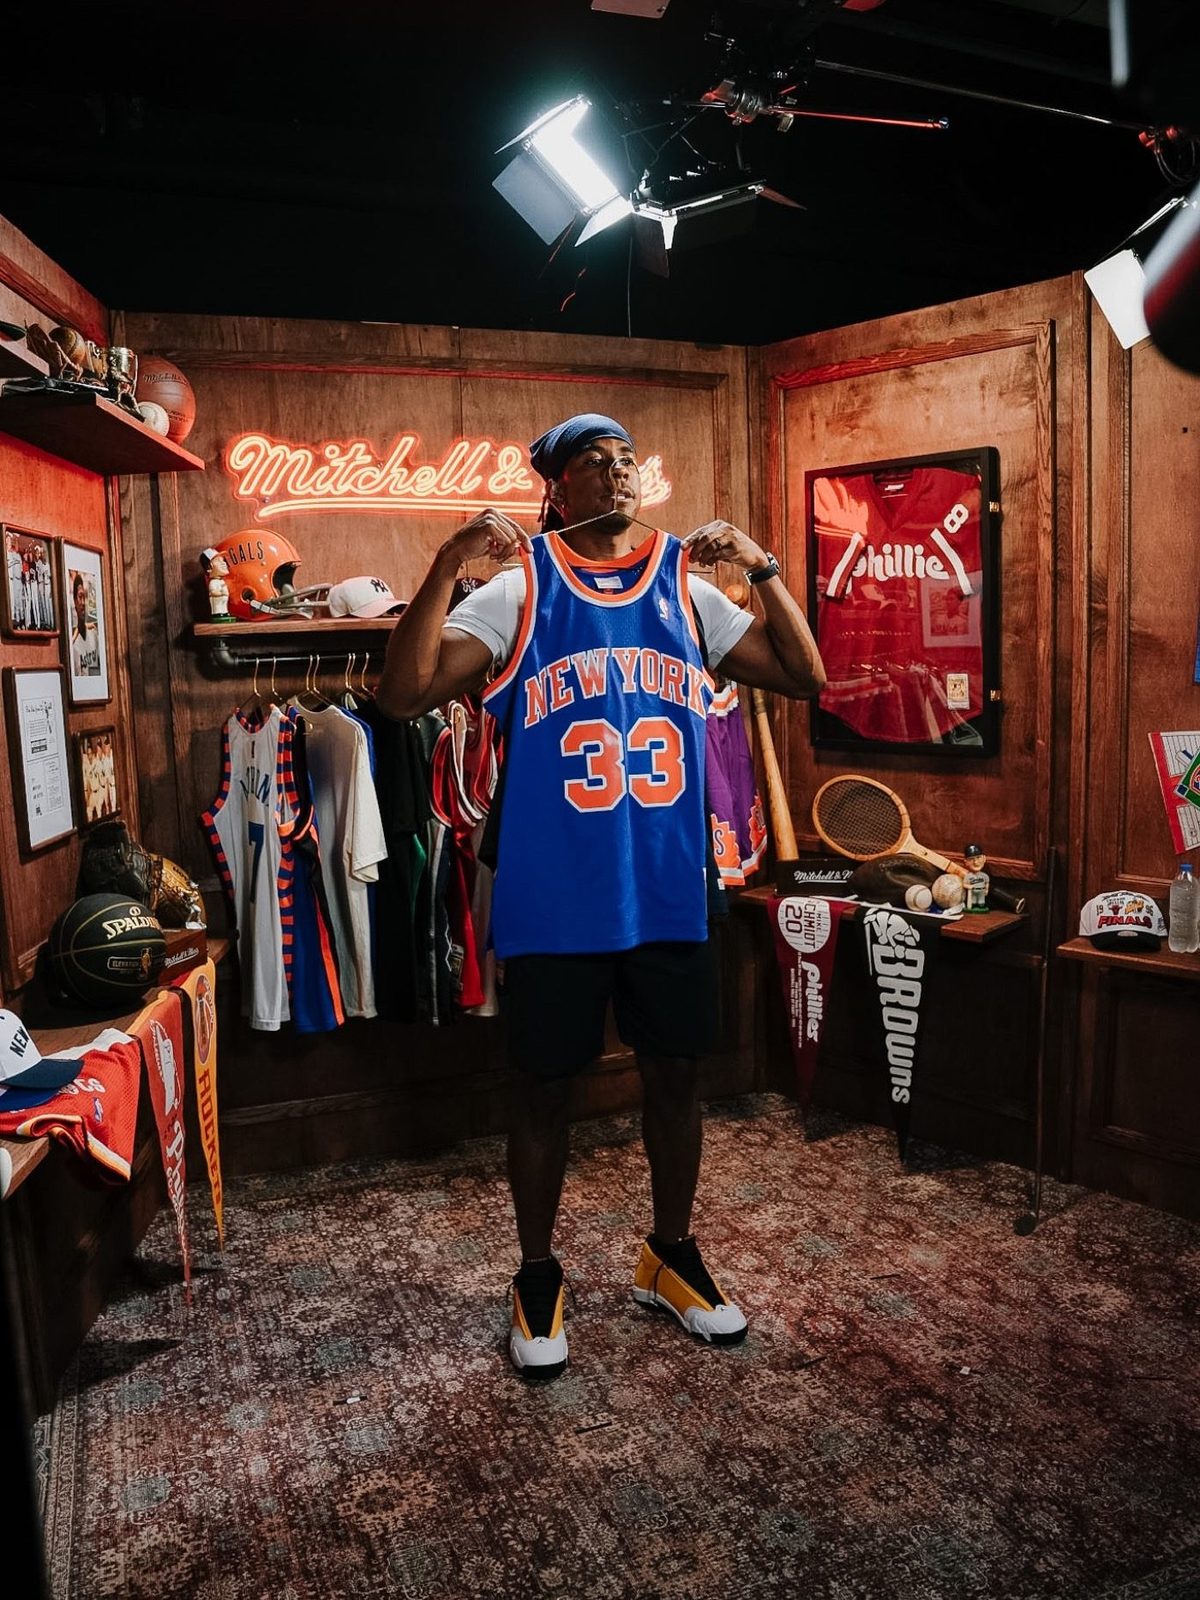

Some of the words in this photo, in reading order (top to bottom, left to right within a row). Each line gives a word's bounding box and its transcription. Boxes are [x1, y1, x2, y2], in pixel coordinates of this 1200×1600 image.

[230, 436, 482, 496] Mitchell
[488, 446, 533, 494] &
[943, 503, 969, 534] 8
[524, 647, 609, 729] NEW
[612, 646, 707, 721] YORK
[560, 716, 686, 813] 33
[785, 904, 803, 934] 20
[1097, 915, 1153, 929] FINALS
[801, 961, 823, 1042] Phillies
